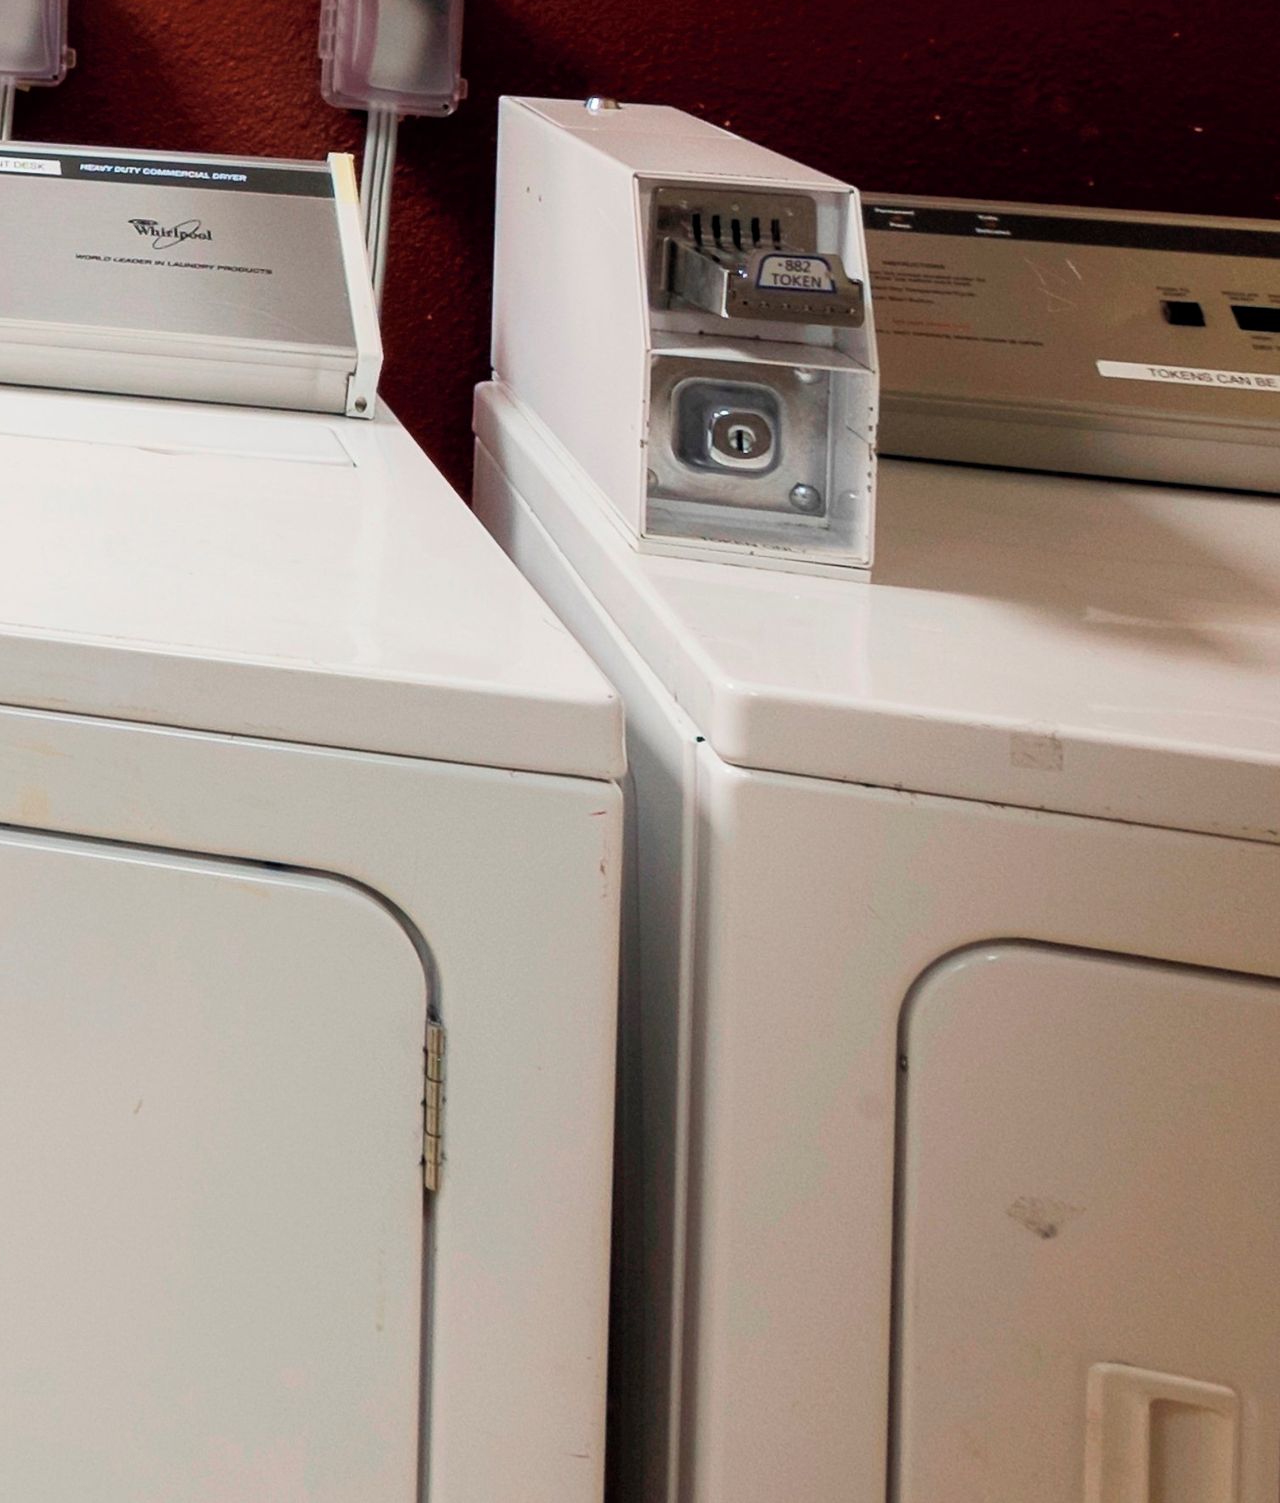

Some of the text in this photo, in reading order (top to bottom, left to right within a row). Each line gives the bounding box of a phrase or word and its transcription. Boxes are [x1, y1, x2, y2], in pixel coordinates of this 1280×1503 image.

[13, 160, 45, 171] DESK
[80, 163, 248, 182] HEAVY DUTY COMMERCIAL DRYER
[133, 223, 213, 245] Whirlpool
[75, 253, 111, 262] WORLD
[113, 257, 152, 265] LEADER
[167, 261, 215, 271] LAUNDRY
[216, 265, 273, 275] PRODUCTS
[771, 272, 822, 288] TOKEN
[1147, 367, 1278, 388] TOKENS CAN BE
